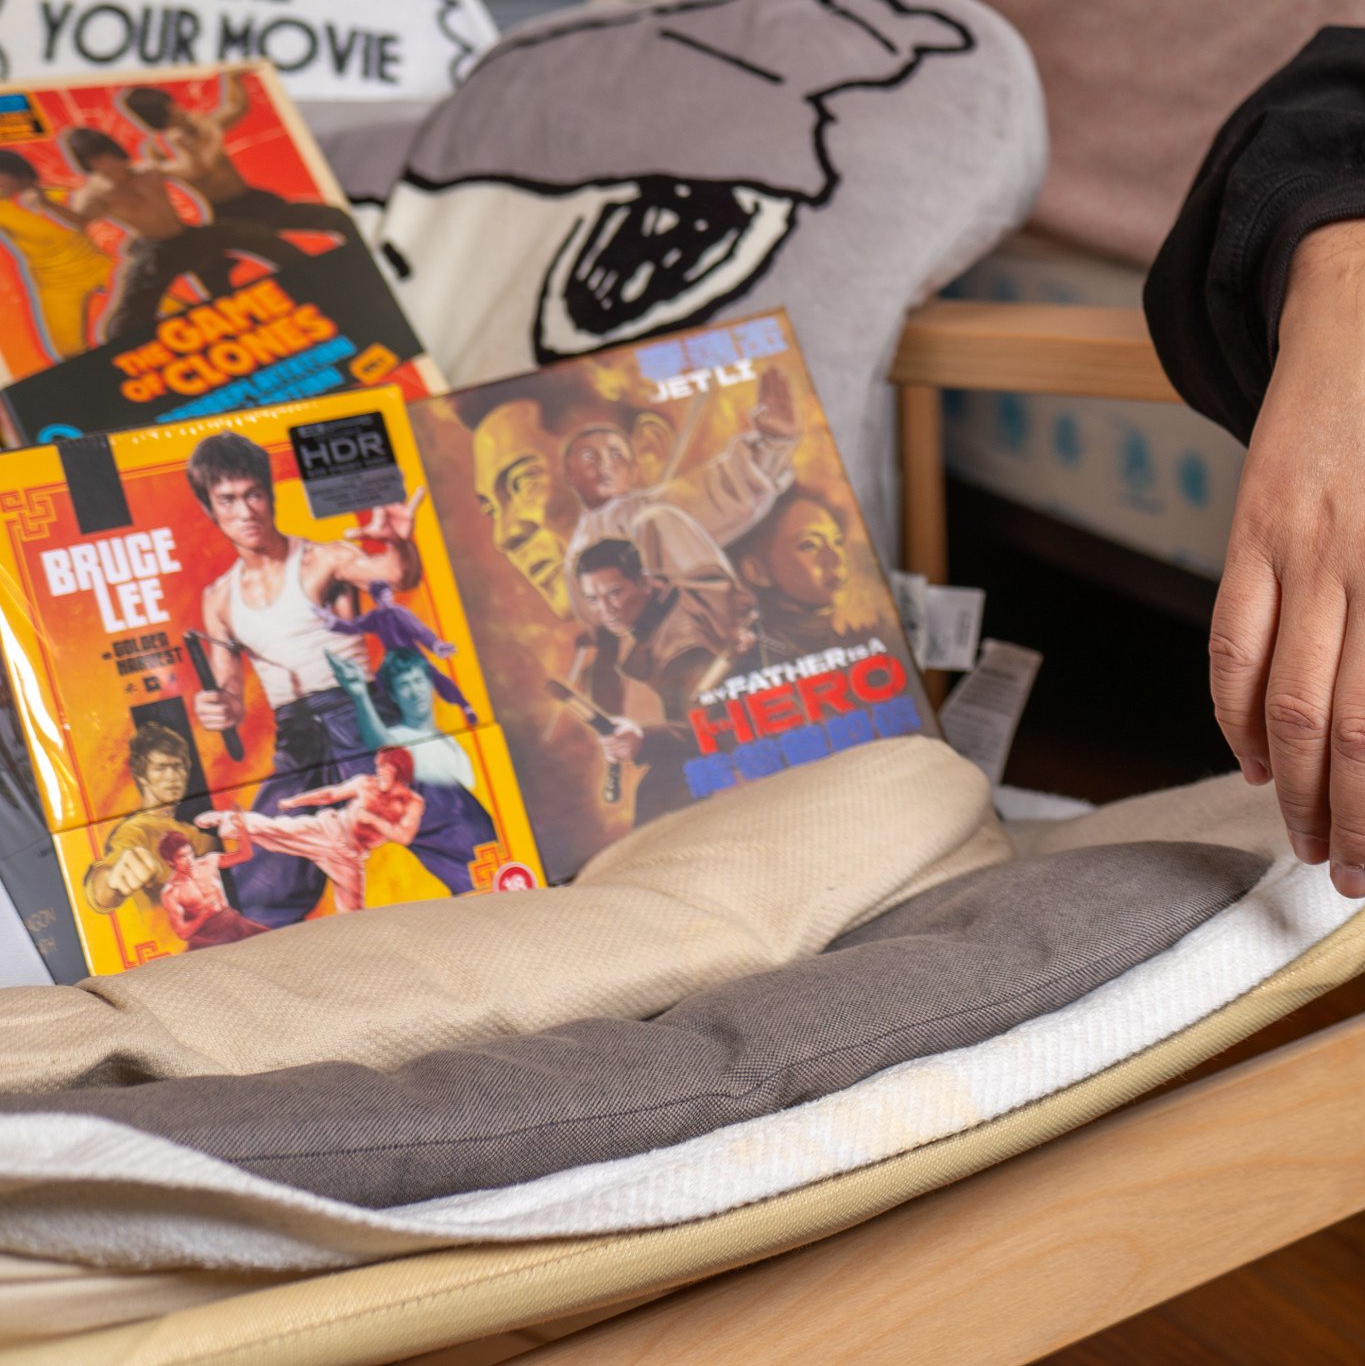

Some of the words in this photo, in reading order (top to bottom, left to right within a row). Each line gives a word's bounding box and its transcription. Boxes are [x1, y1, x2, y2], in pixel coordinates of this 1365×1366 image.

[217, 10, 404, 84] MOVIE
[157, 278, 296, 354] GAME
[162, 303, 337, 394] CLONES
[648, 368, 711, 402] JET
[713, 358, 757, 387] LI
[301, 433, 386, 469] HDR
[40, 527, 182, 596] BRUCE
[93, 574, 171, 634] LEE
[723, 646, 850, 699] FATHER
[868, 637, 888, 655] A
[688, 653, 907, 754] HERO
